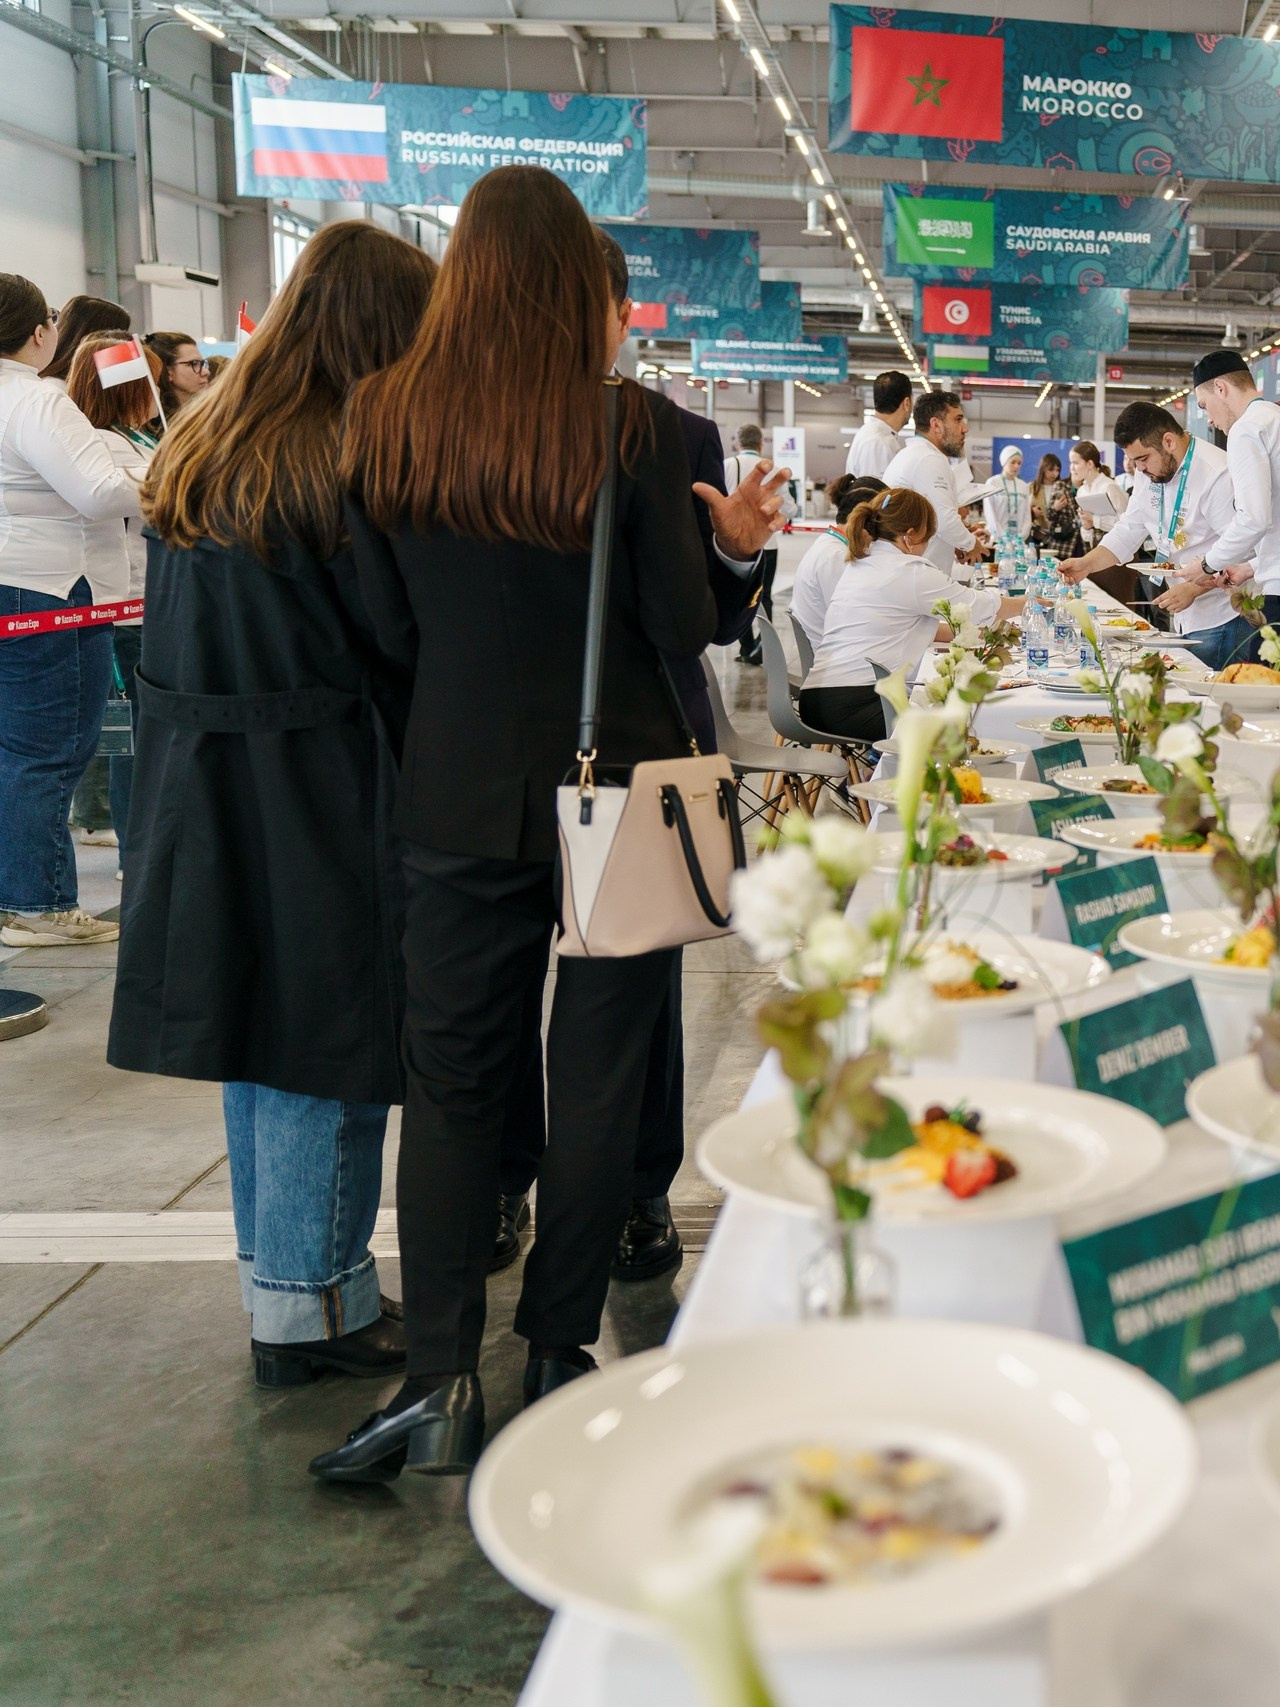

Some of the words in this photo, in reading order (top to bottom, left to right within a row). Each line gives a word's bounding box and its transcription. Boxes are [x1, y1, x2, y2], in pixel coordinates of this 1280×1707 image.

[1022, 75, 1132, 99] МАРОККО
[1022, 96, 1143, 120] MOROCCO
[401, 131, 515, 150] РОССИЙСКАЯ
[519, 137, 624, 157] ФЕДЕРАЦИЯ
[402, 149, 485, 167] RUSSIAN
[490, 153, 609, 173] FEDERATION
[1006, 225, 1095, 241] САУДОВСКАЯ
[1097, 231, 1151, 244] АРАВИЯ
[1006, 238, 1051, 251] SAUDI
[1053, 241, 1111, 255] ARABIA
[1000, 315, 1042, 325] TUNISIA
[15, 621, 28, 630] Kazan
[28, 619, 39, 630] Expo
